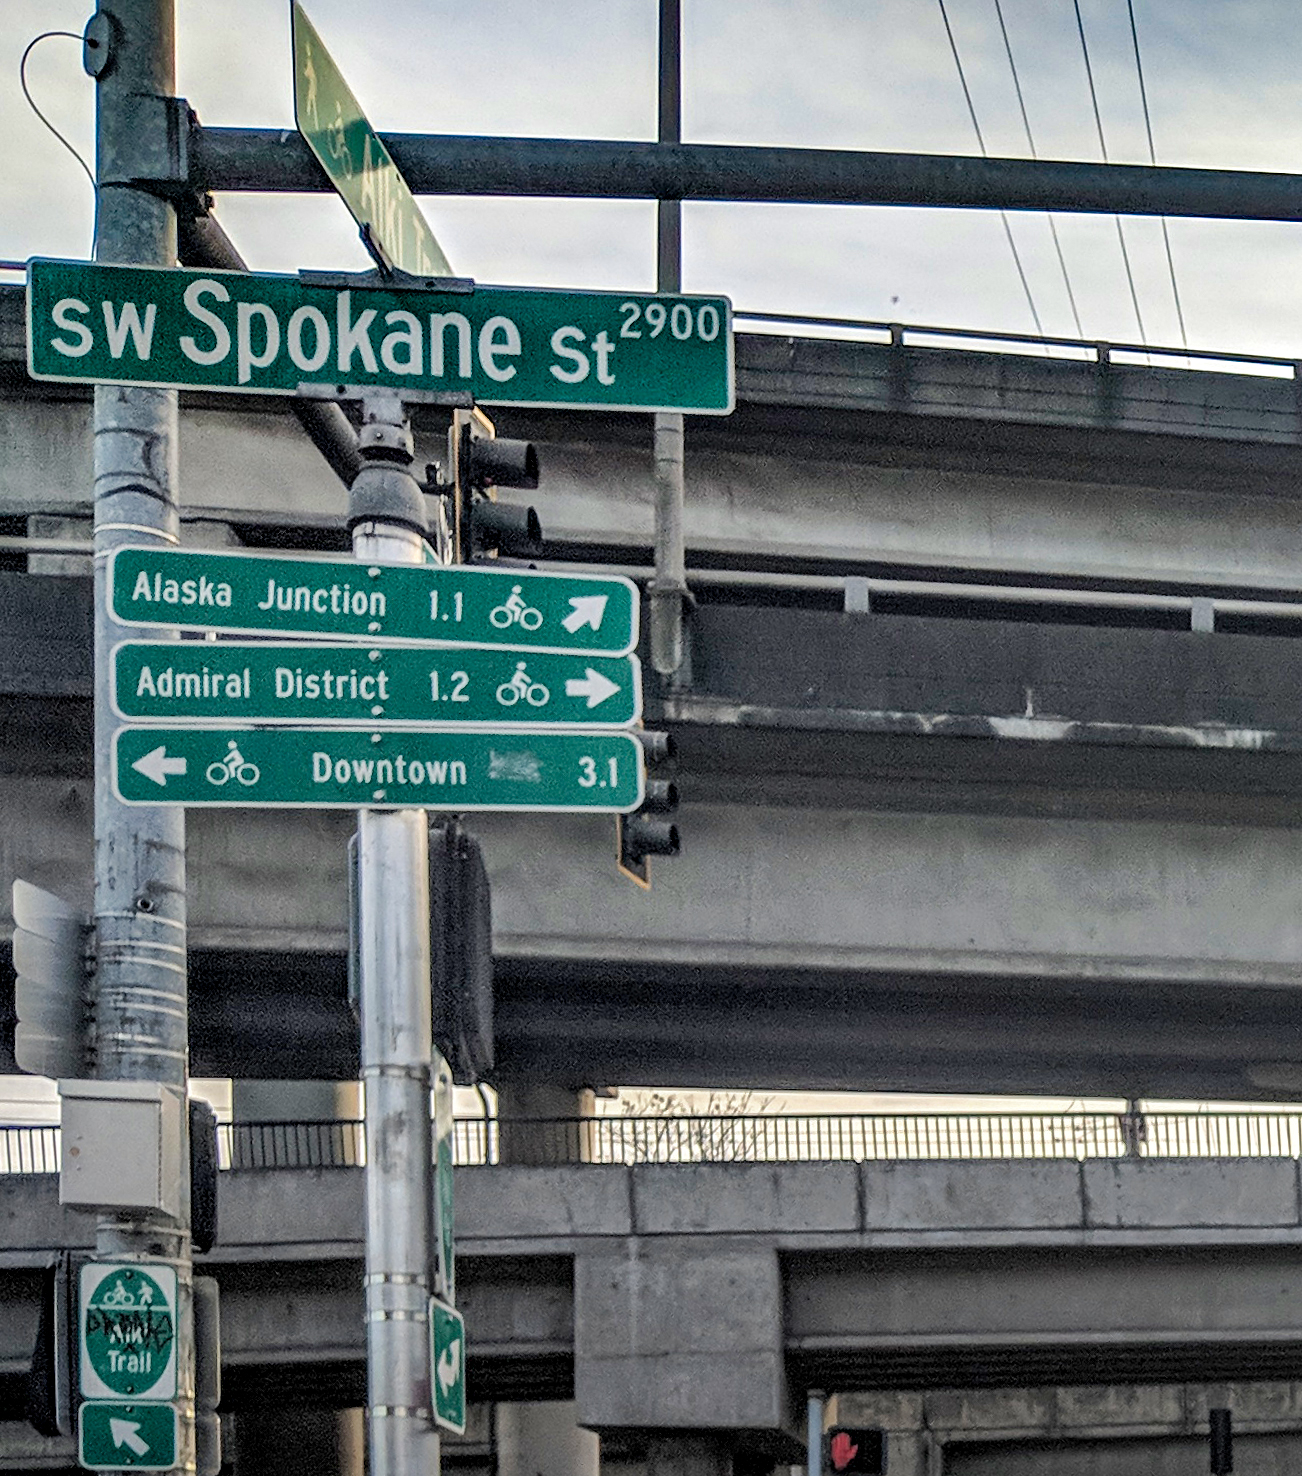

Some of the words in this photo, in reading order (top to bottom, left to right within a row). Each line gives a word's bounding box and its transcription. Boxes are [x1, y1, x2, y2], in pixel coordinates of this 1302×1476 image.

[50, 297, 157, 361] SW
[179, 279, 522, 384] Spokane
[549, 325, 616, 386] St
[619, 302, 720, 342] 2900
[132, 570, 232, 607] Alaska
[258, 580, 386, 617] Junction
[429, 589, 463, 622] 1.1
[136, 666, 251, 699] Admiral
[275, 667, 390, 700] District
[429, 670, 470, 702] 1.2
[312, 751, 467, 785] Downtown
[577, 755, 618, 788] 3.1
[107, 1350, 152, 1373] Trail
